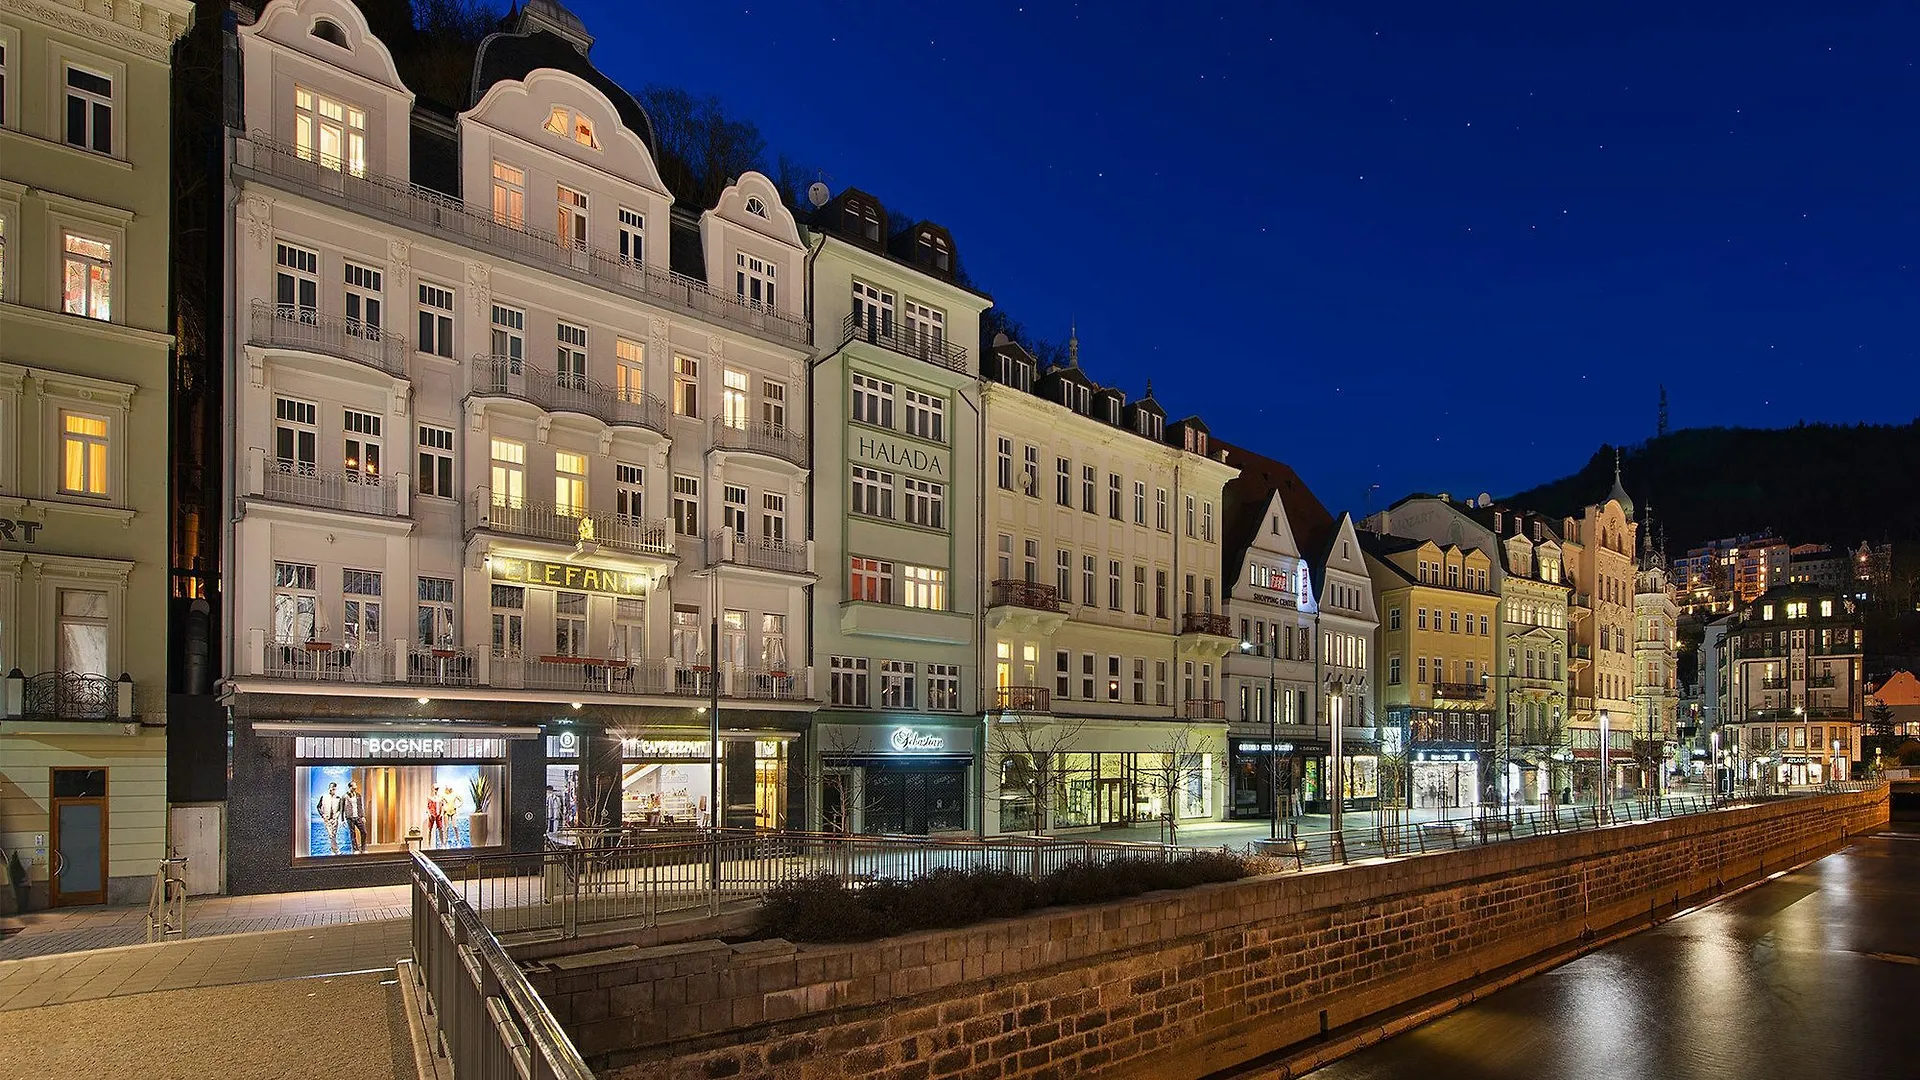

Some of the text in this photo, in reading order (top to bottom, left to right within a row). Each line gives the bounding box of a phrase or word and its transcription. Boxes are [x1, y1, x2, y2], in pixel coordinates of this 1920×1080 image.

[859, 436, 943, 476] HALADA
[503, 558, 638, 594] ELEFANT
[1253, 592, 1279, 605] SHOPPING
[368, 738, 445, 753] BOGNER
